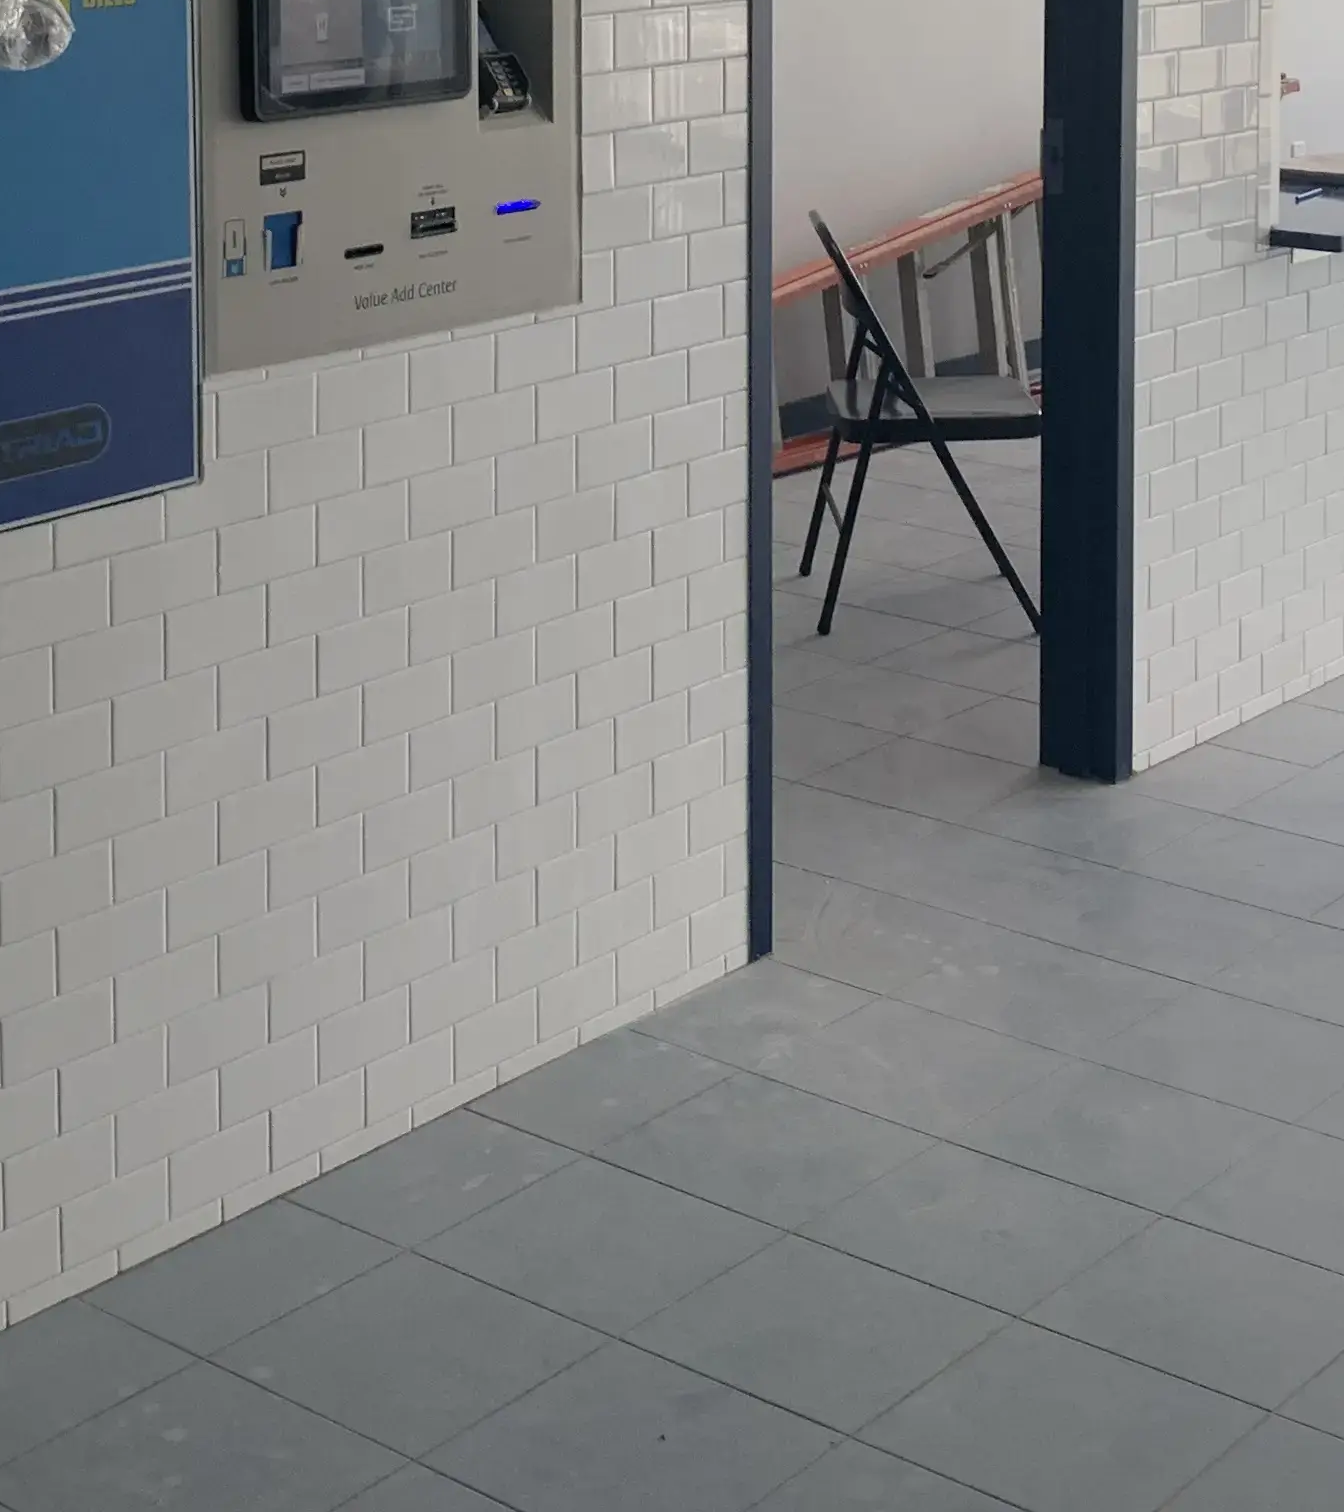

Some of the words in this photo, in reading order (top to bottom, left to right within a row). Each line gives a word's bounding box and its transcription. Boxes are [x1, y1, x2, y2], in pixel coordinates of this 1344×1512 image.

[354, 292, 389, 311] Value
[390, 284, 415, 303] Add
[419, 279, 458, 299] Center
